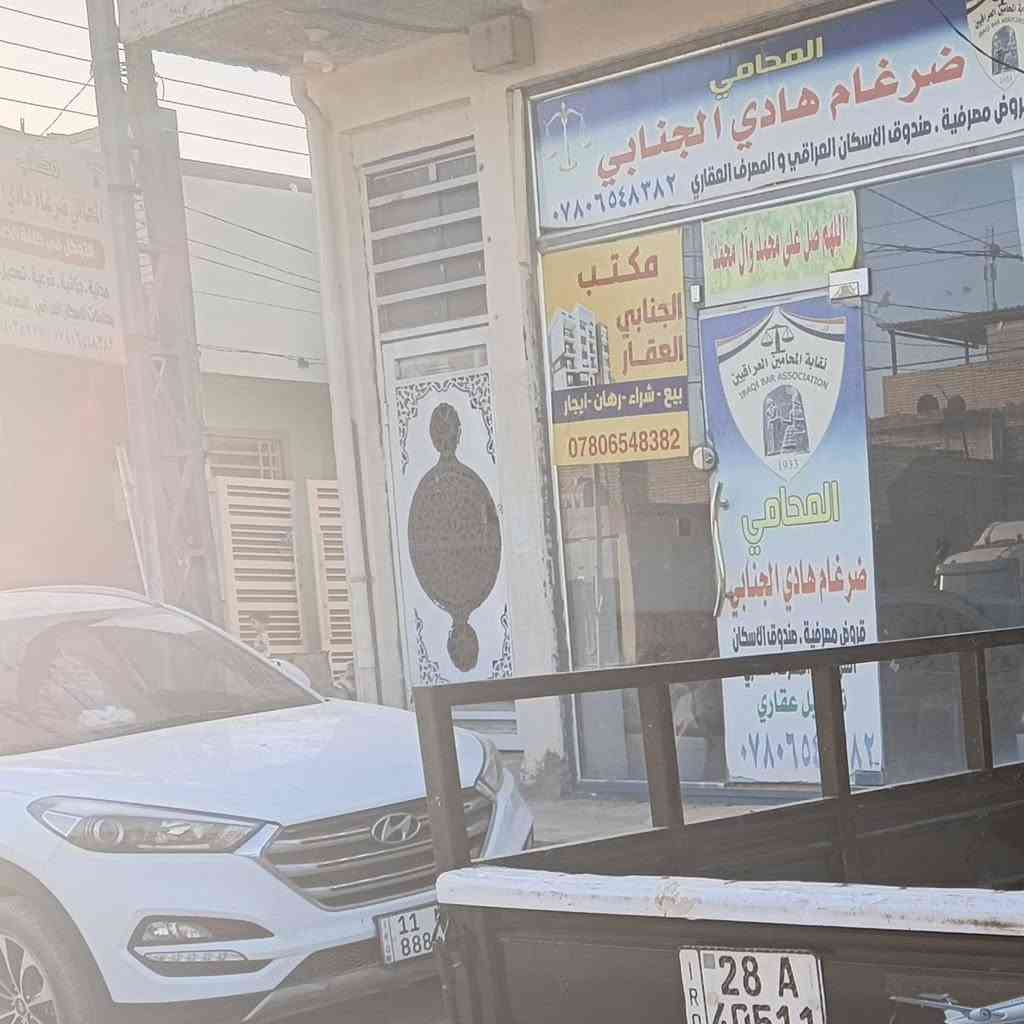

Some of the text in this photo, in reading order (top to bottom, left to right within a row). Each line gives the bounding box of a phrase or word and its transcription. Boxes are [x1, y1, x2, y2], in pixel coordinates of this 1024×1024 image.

[709, 36, 824, 100] المحامي
[596, 47, 966, 187] ضرغام هادي الجنابي
[788, 136, 836, 172] العراقي
[691, 163, 732, 200] العقاري
[577, 245, 658, 297] مكتب
[568, 428, 681, 458] 07806548382
[741, 480, 840, 556] المحامي
[782, 560, 816, 612] هادي
[819, 553, 867, 605] ضرغام
[840, 620, 866, 646] قروض
[757, 687, 798, 723] عقاري
[398, 912, 420, 936] 11
[718, 955, 799, 998] 28 A
